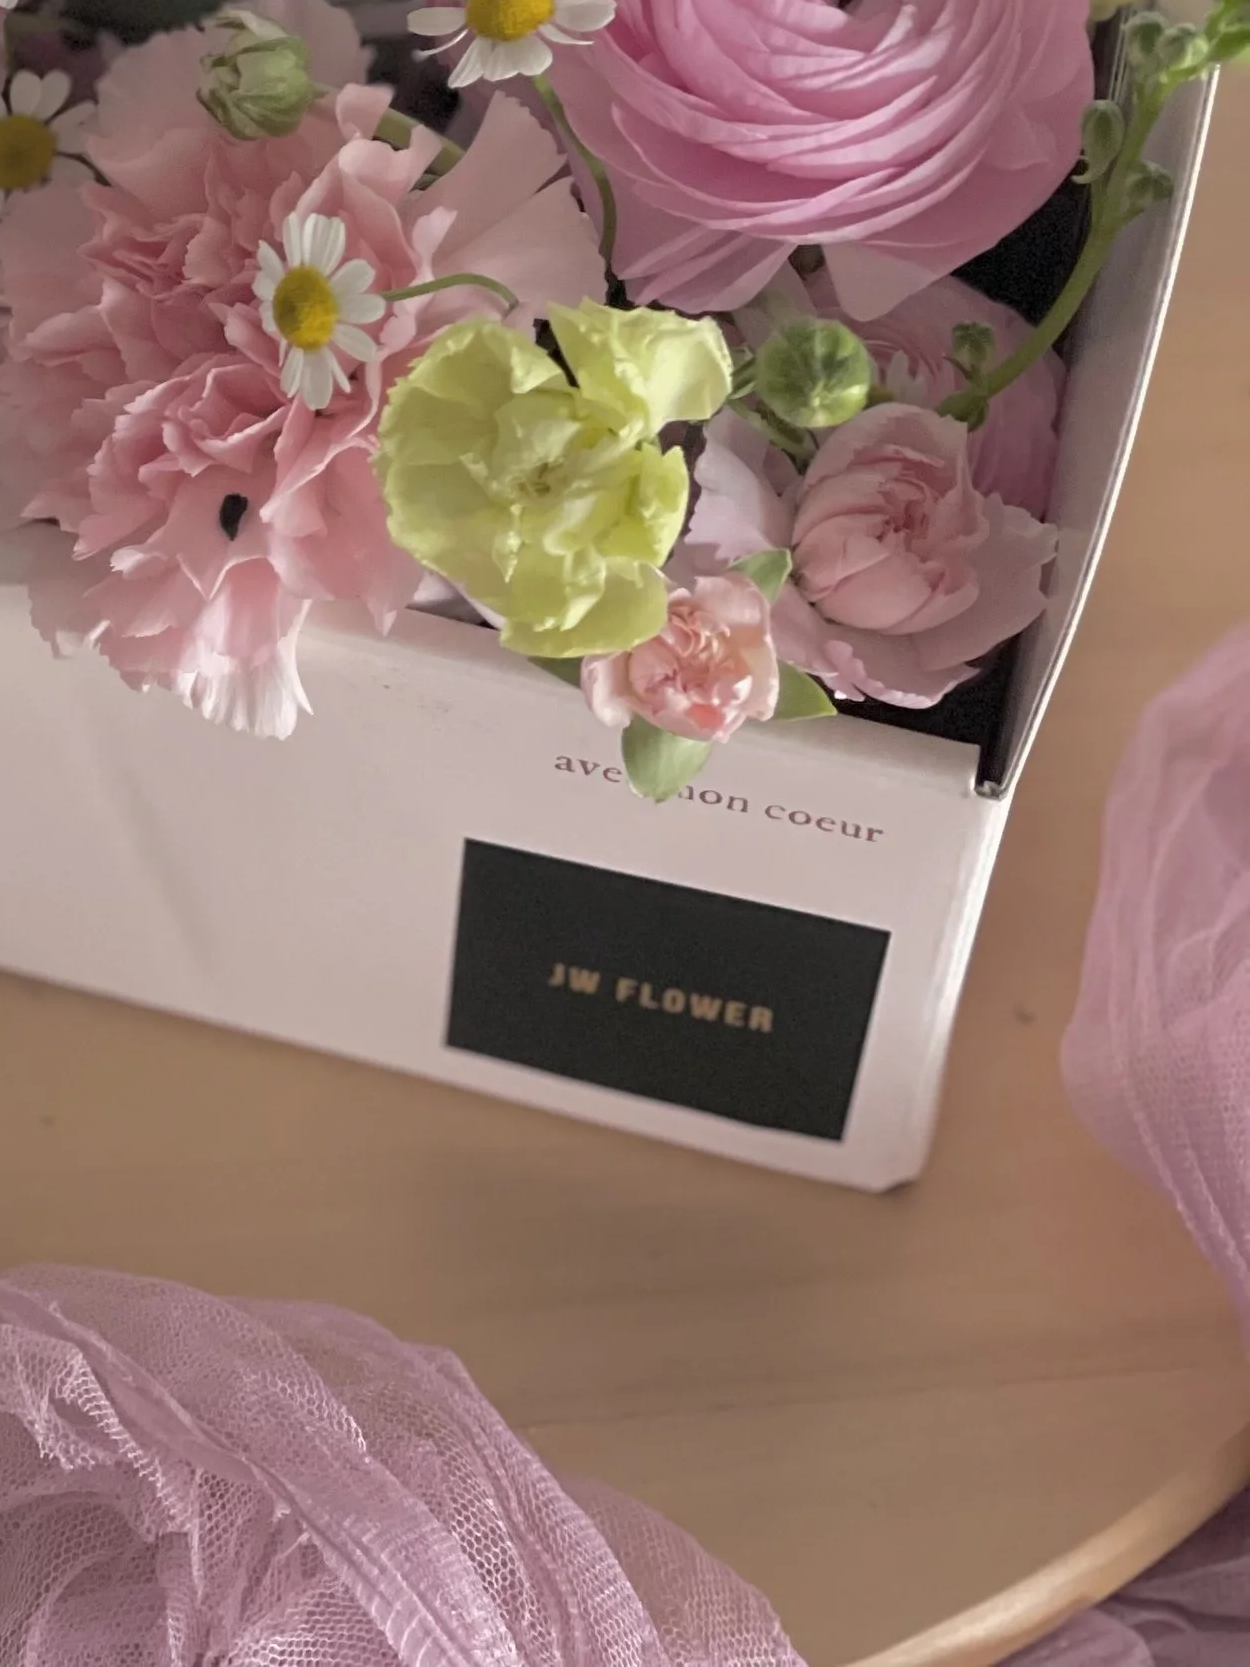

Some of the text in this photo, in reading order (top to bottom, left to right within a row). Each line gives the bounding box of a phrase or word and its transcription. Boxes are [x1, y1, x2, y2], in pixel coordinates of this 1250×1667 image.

[553, 753, 623, 783] ave
[763, 802, 885, 843] coeur
[548, 962, 774, 1033] JW FLOWER
